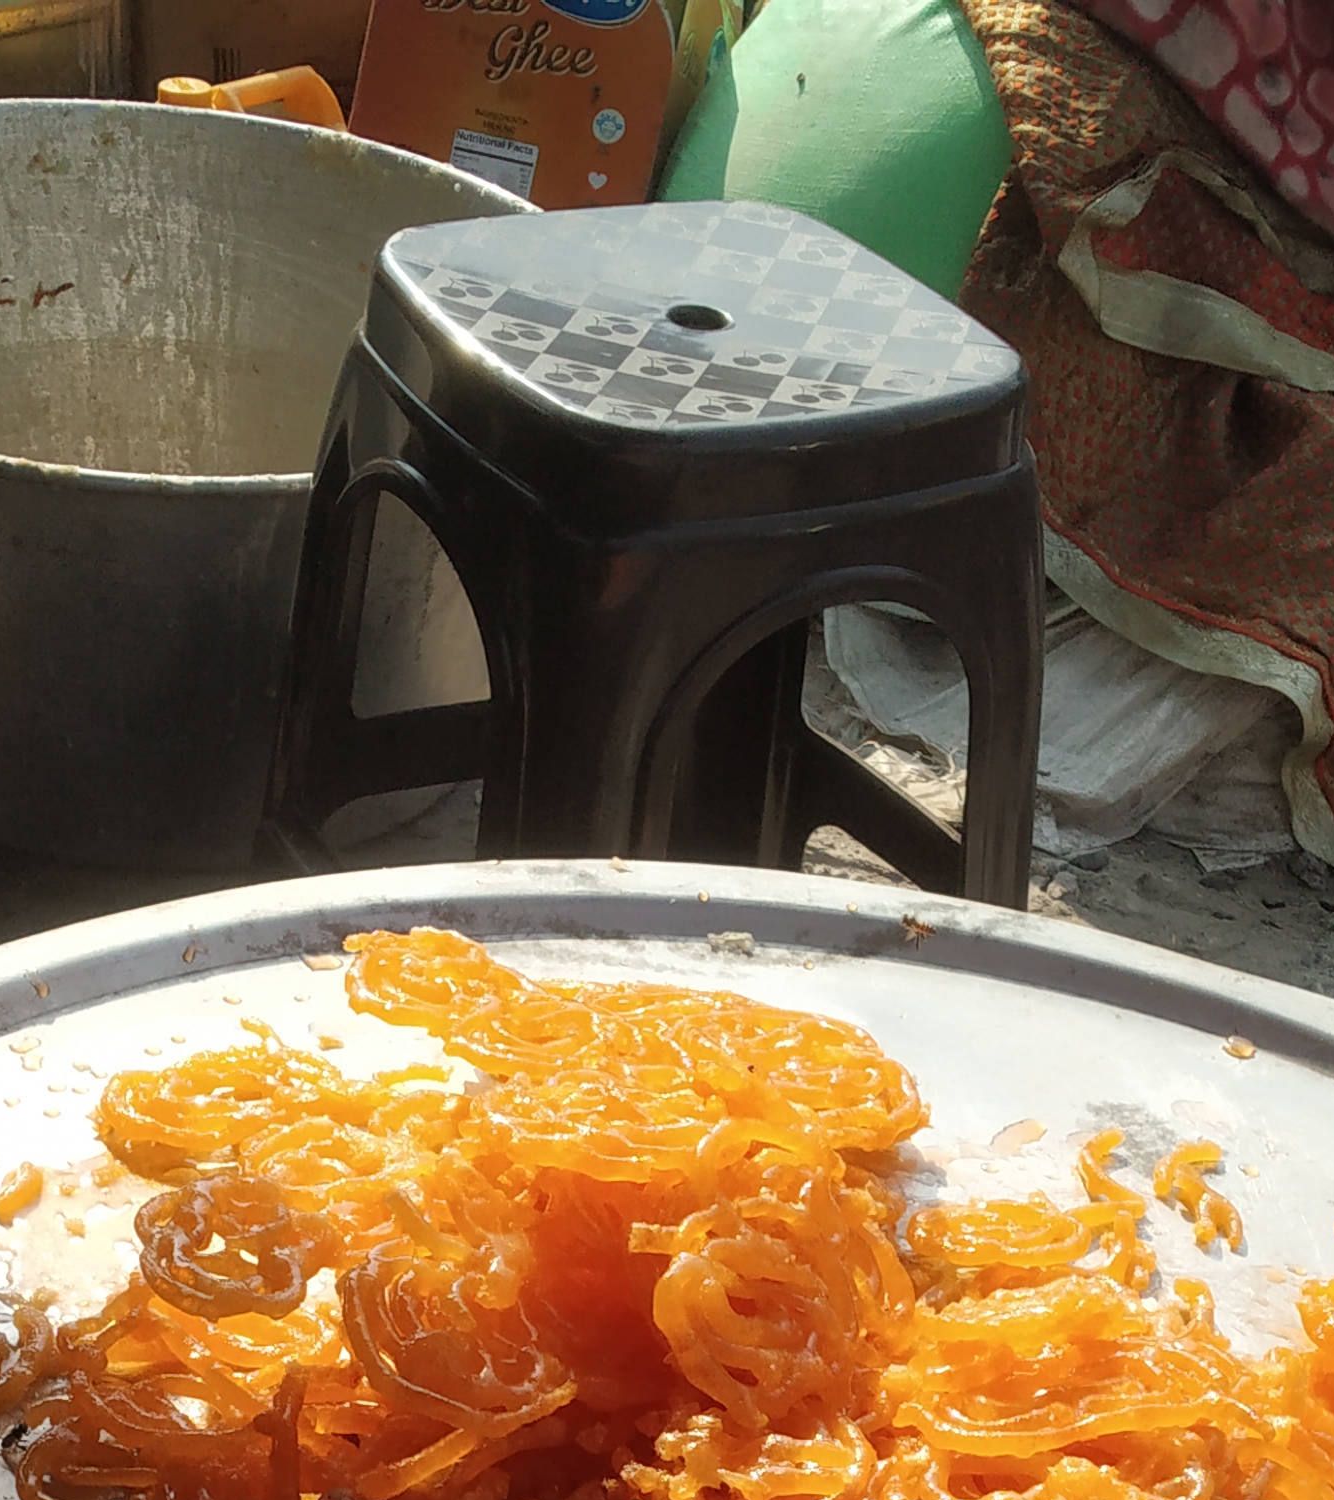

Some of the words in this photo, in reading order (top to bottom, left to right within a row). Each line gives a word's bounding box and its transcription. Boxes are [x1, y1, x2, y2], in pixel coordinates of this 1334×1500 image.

[485, 20, 598, 83] Ghee
[455, 130, 506, 150] Nutritional
[507, 141, 534, 155] Facts
